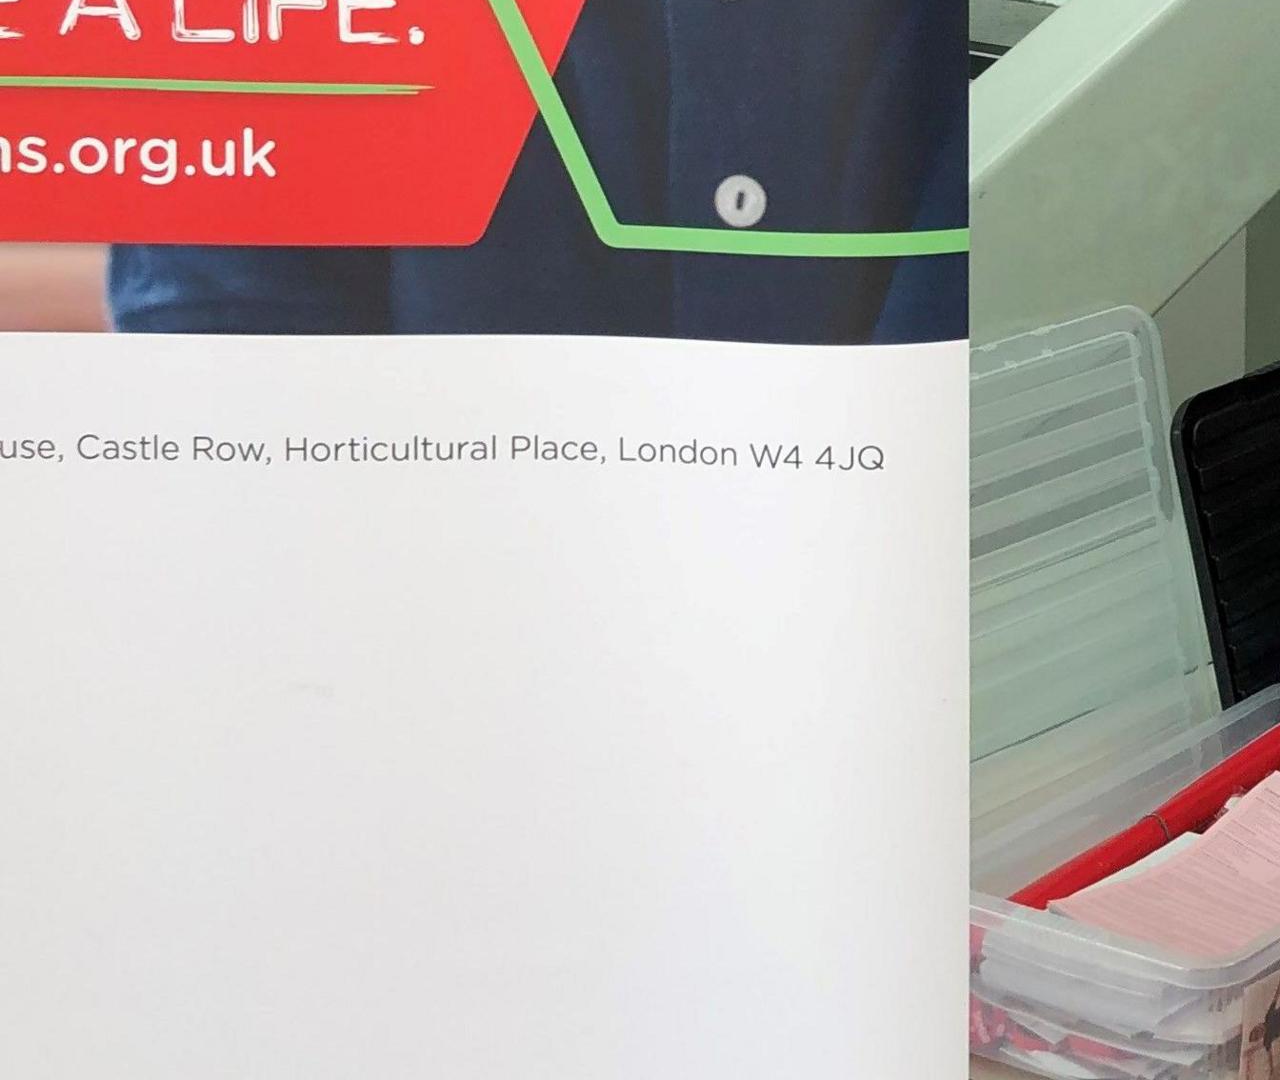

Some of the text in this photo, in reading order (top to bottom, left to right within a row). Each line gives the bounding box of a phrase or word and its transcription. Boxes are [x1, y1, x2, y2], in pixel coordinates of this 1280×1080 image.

[0, 434, 885, 472] use, Castle Row, Horticultural Place, London W4 4JQ
